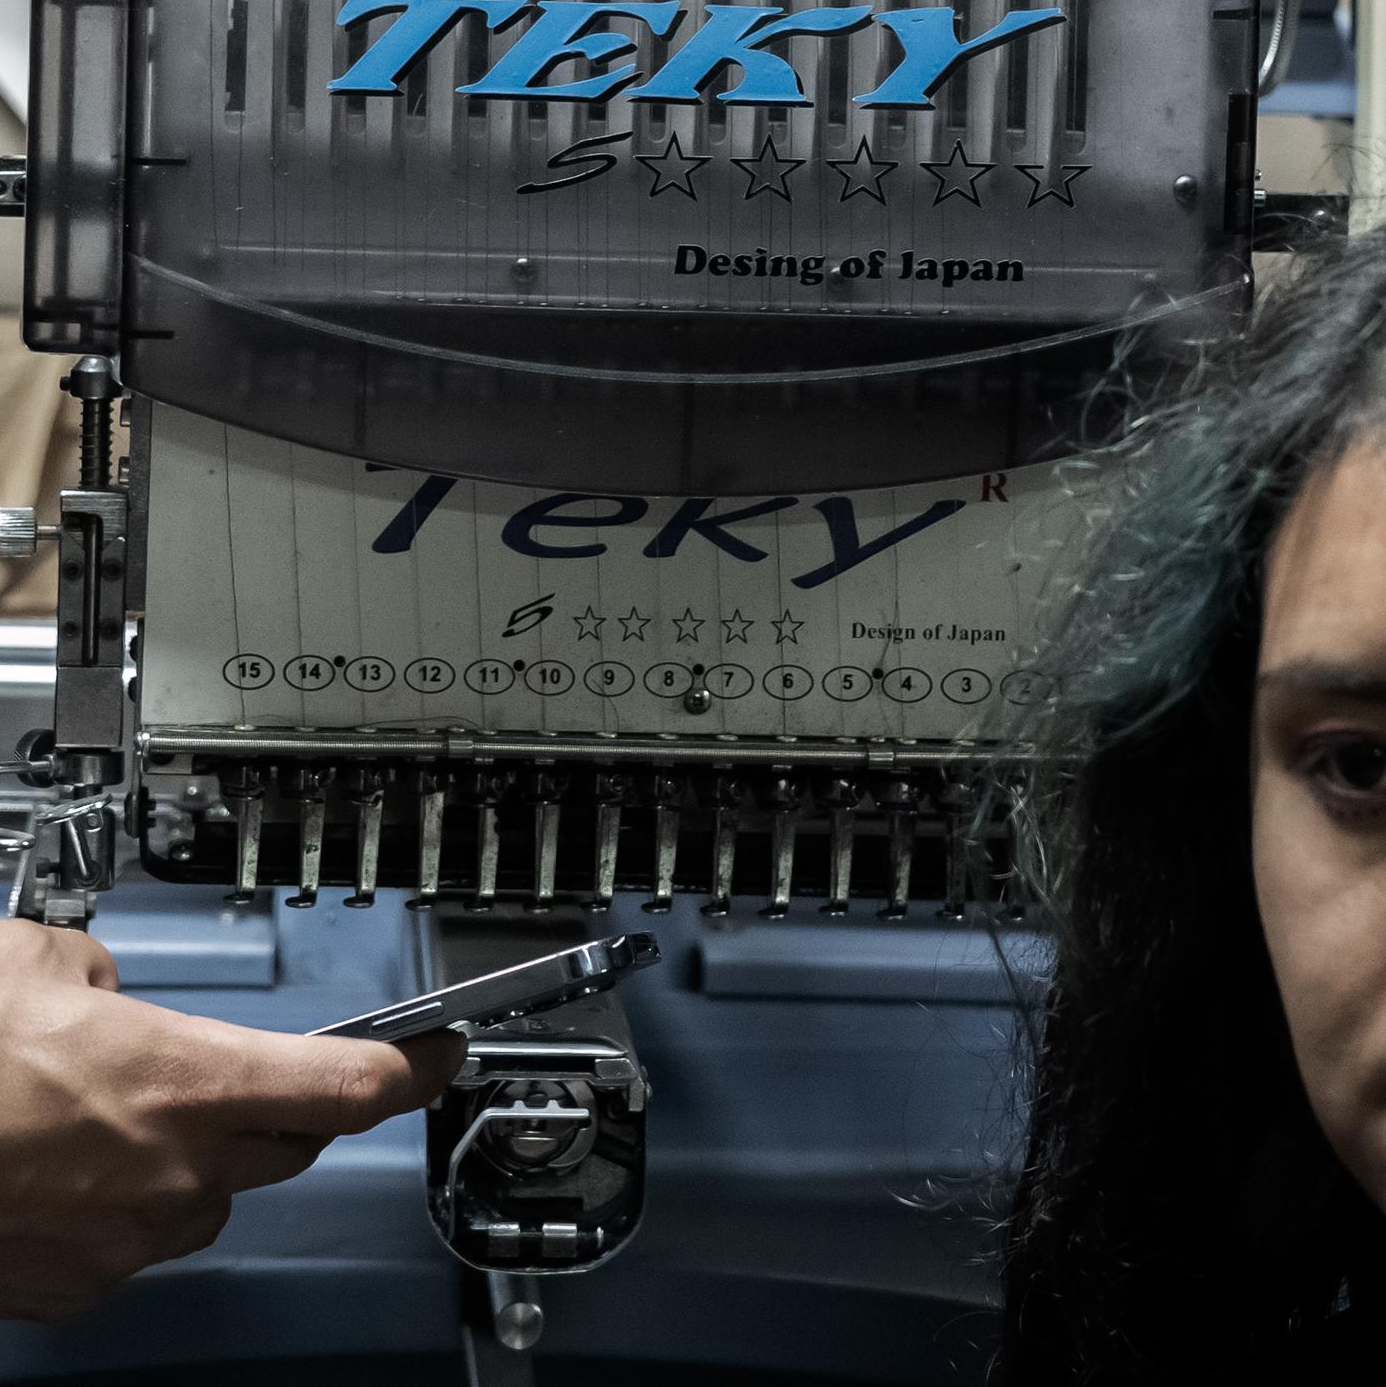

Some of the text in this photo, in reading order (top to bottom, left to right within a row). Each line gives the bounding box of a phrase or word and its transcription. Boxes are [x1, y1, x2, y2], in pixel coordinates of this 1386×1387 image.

[673, 243, 1025, 288] Desing of Japan
[979, 471, 1010, 503] R
[850, 621, 1007, 645] Design of Japan
[238, 663, 262, 679] 15
[298, 663, 321, 680] 14
[359, 664, 381, 681] 13
[418, 666, 441, 683] 12
[479, 667, 500, 683] 11
[539, 668, 561, 684] 10
[603, 669, 614, 685] 9
[663, 670, 674, 686] 8
[723, 672, 734, 688] 7
[782, 673, 794, 689] 6
[843, 674, 854, 690] 5
[901, 675, 913, 691] 4
[961, 677, 972, 693] 3
